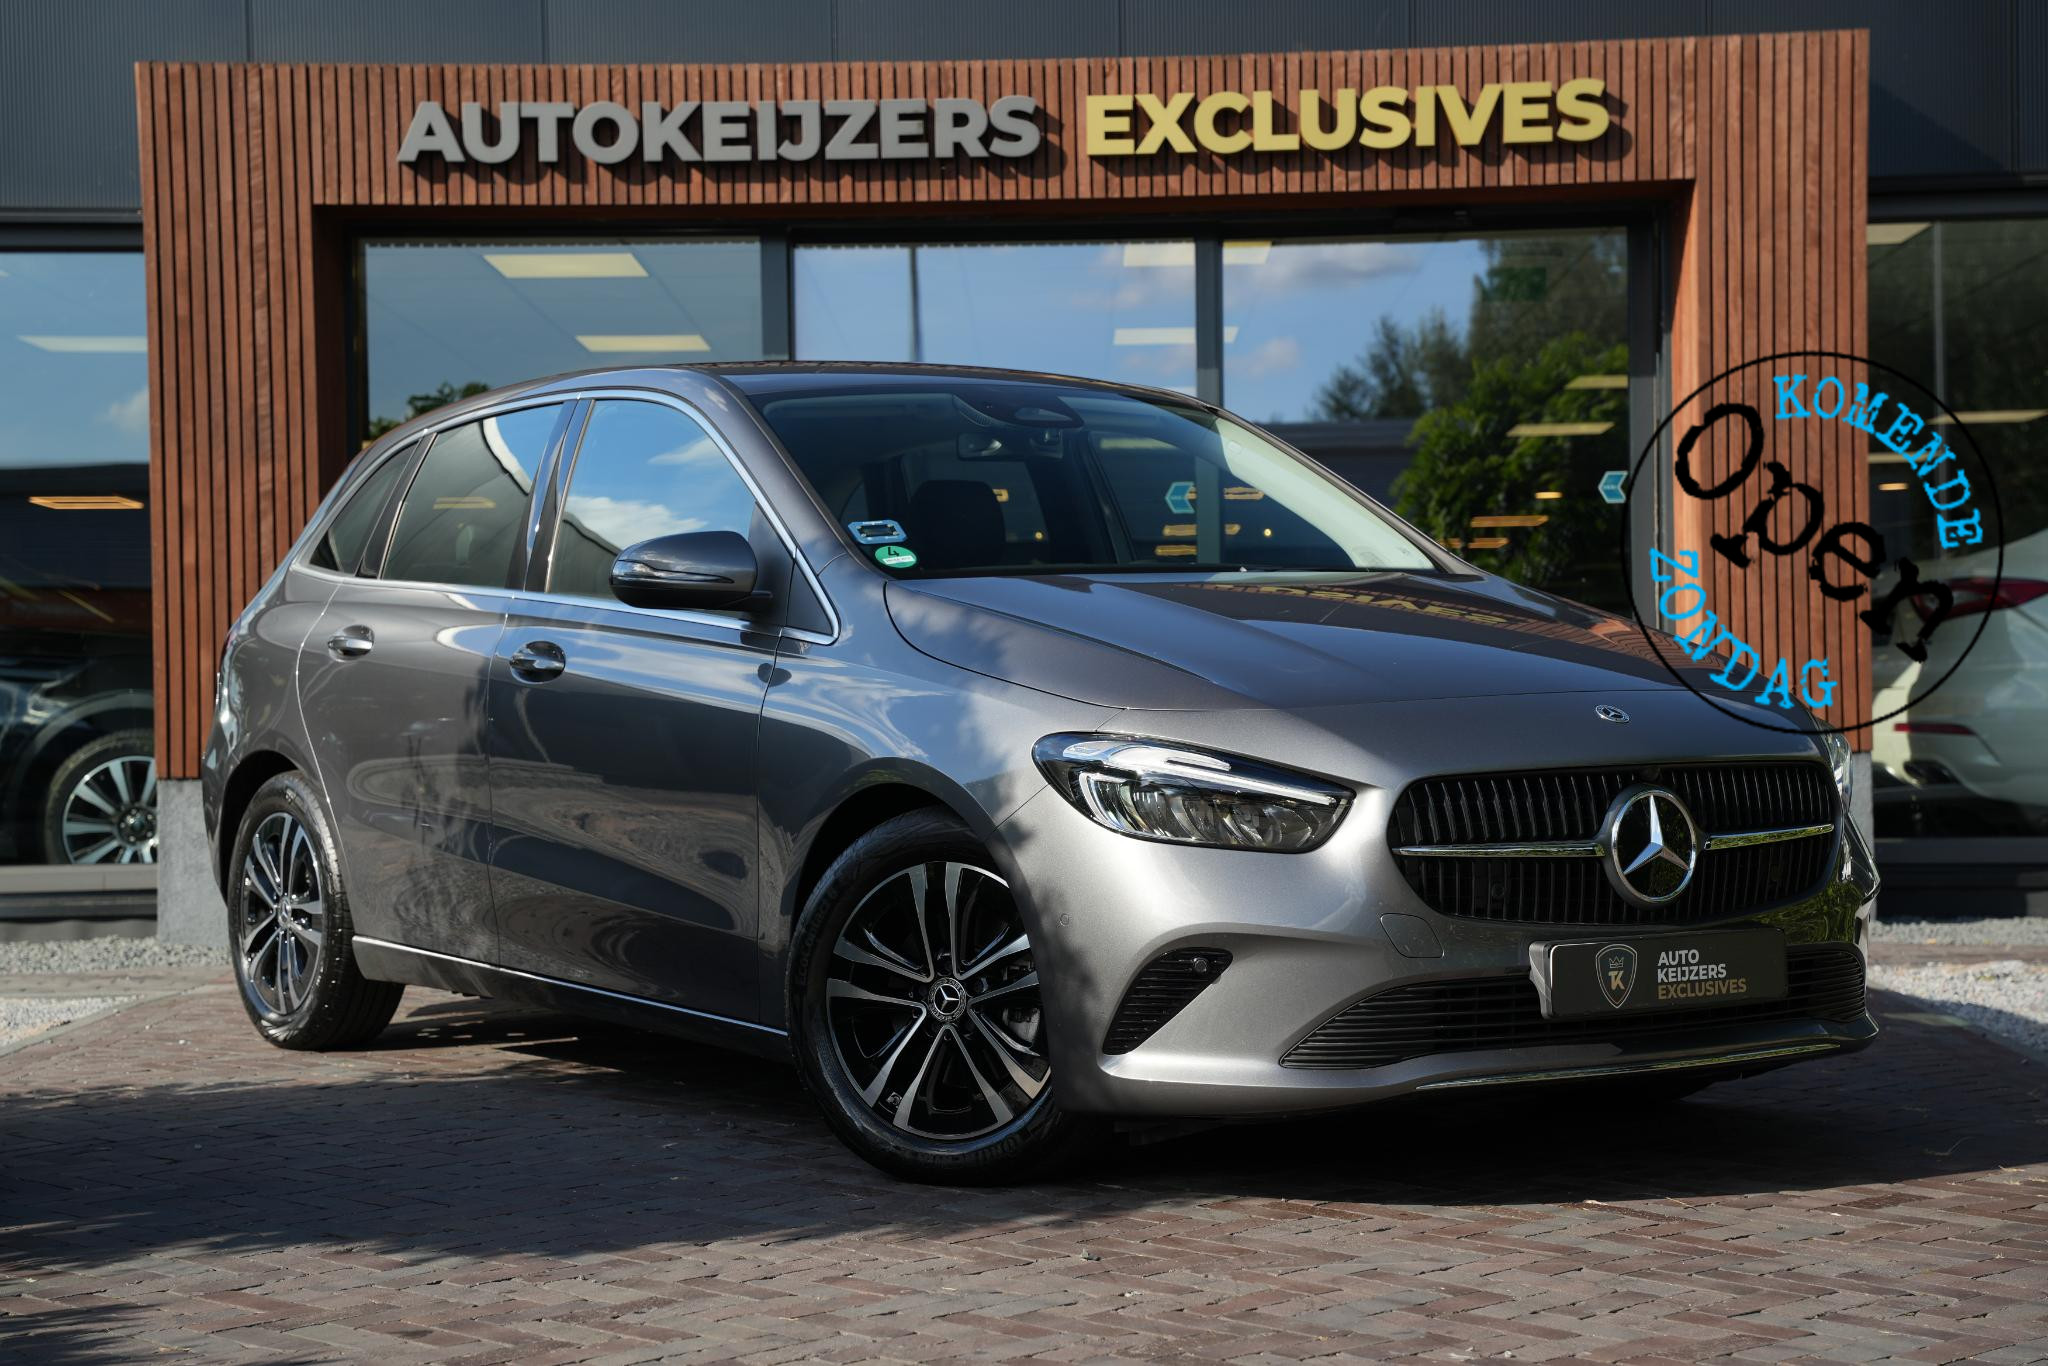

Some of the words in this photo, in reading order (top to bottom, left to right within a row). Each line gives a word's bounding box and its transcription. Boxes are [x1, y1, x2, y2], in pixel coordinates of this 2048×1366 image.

[397, 95, 1040, 163] AUTOKEIJZERS
[1086, 77, 1611, 157] EXCLUSIVES
[1658, 949, 1700, 967] AUTO
[1657, 963, 1727, 983] KEIJZERS
[1657, 978, 1747, 1000] EXCLUSIVES
